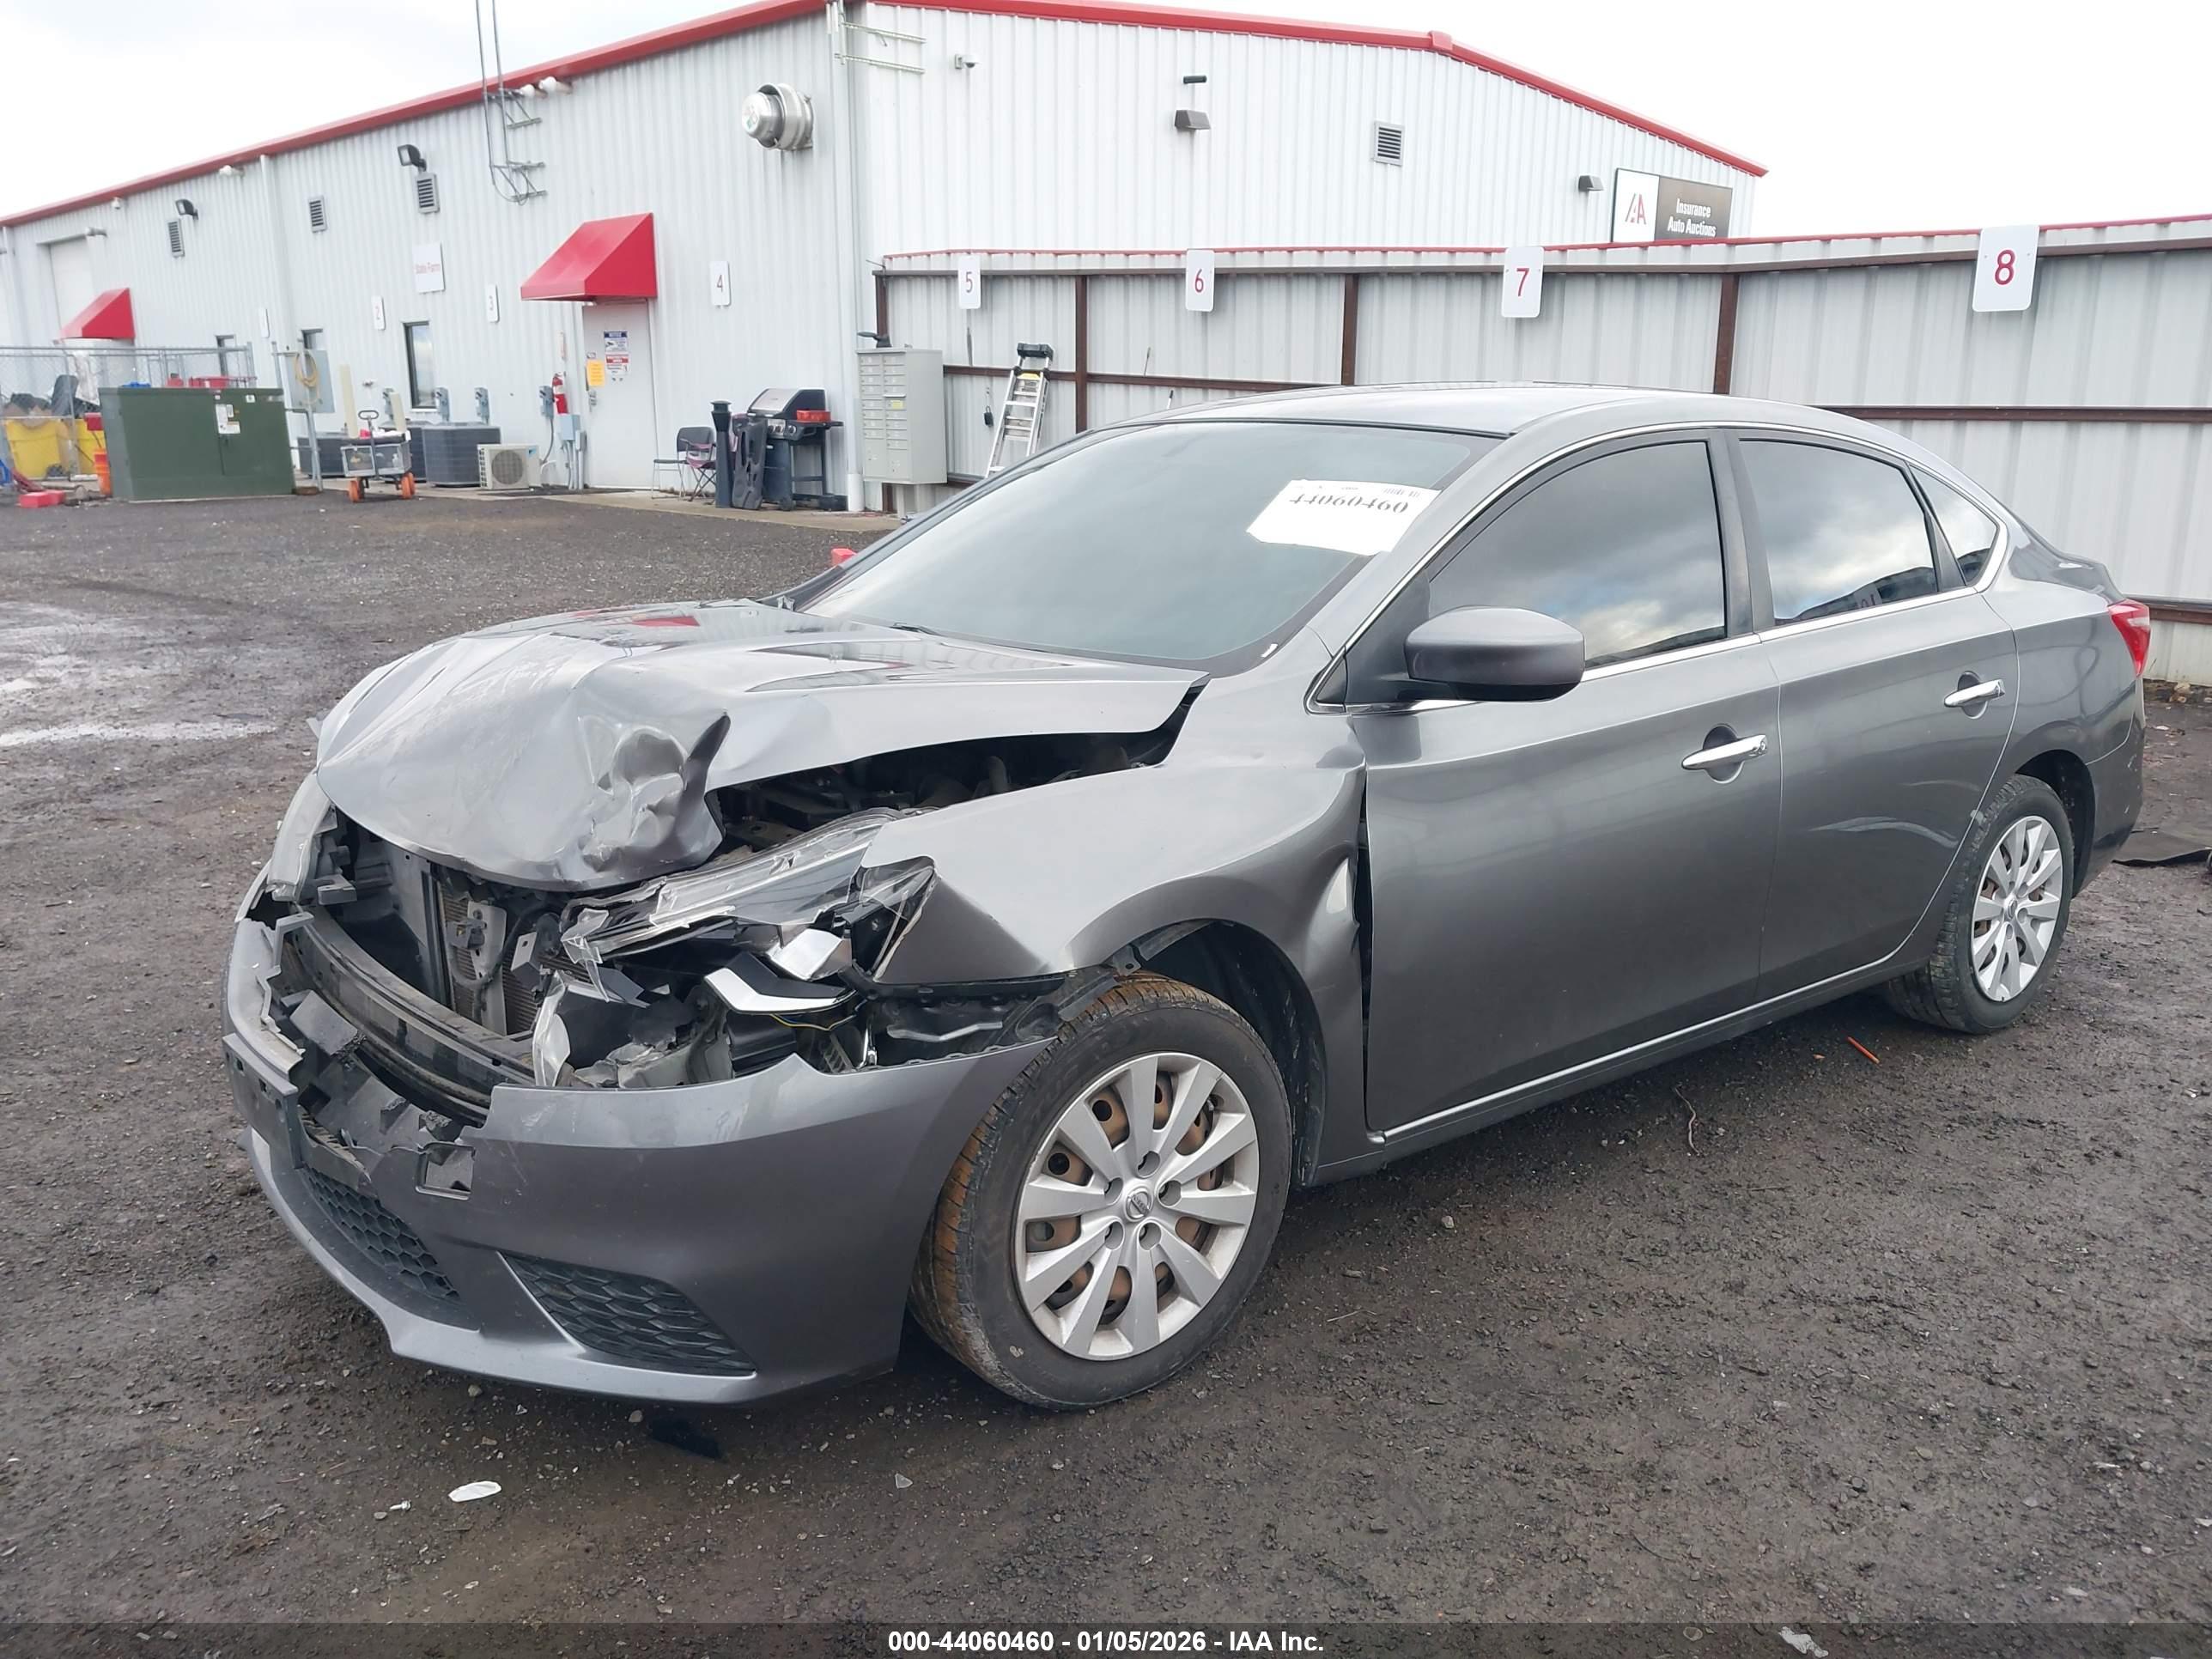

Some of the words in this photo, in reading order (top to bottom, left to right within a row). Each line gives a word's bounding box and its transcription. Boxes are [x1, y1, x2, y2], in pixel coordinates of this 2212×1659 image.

[1675, 198, 1711, 218] Insurance
[1668, 215, 1685, 234] Auto
[1686, 218, 1717, 238] Auctions
[1994, 248, 2015, 285] 8
[716, 274, 723, 293] 4
[966, 270, 973, 293] 5
[1194, 268, 1204, 293] 6
[1516, 268, 1529, 297] 7
[1289, 493, 1409, 514] 44060460
